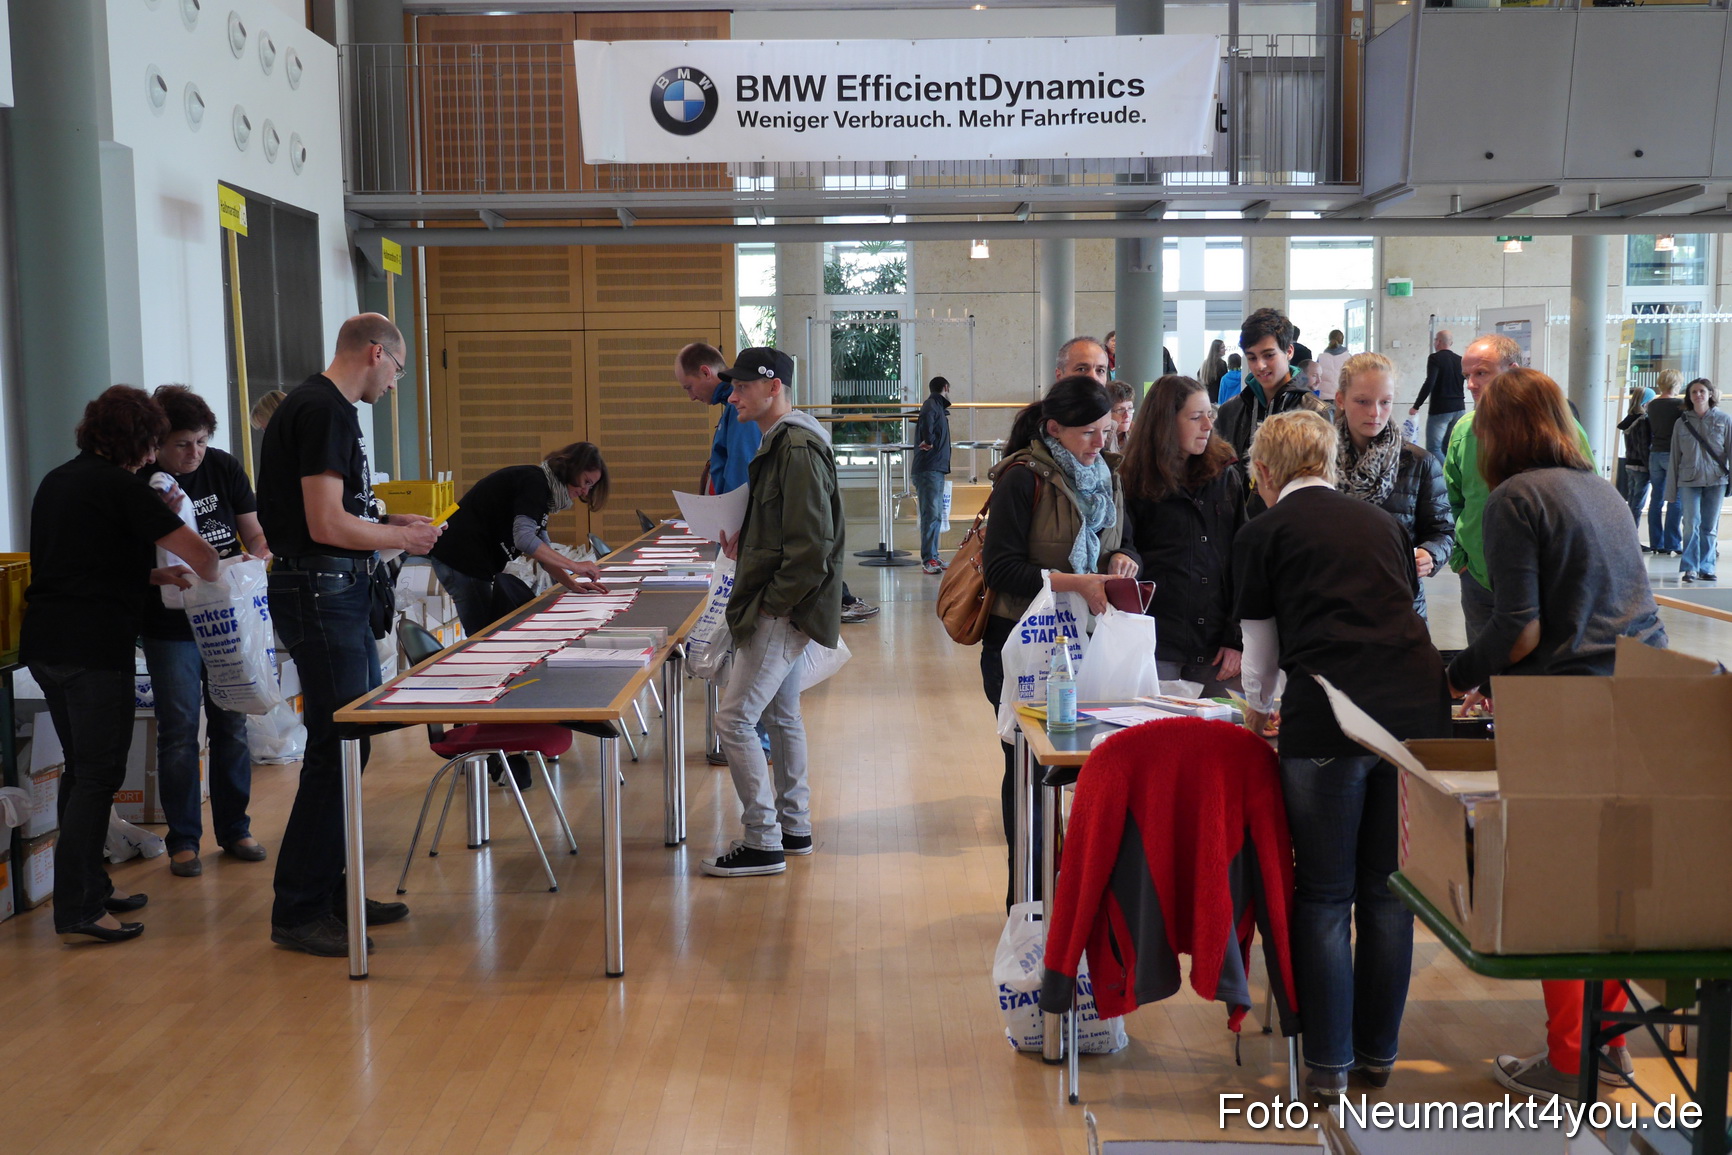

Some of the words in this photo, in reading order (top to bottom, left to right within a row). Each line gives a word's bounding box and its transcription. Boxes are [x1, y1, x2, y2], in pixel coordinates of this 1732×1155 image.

[656, 68, 713, 91] BMW
[736, 74, 826, 102] BMW
[837, 71, 1146, 108] EfficientDynamics
[736, 110, 829, 132] Weniger
[833, 109, 952, 129] Verbrauch.
[959, 109, 1016, 128] Mehr
[1020, 105, 1147, 127] Fahrfreude.
[193, 607, 235, 625] arkter
